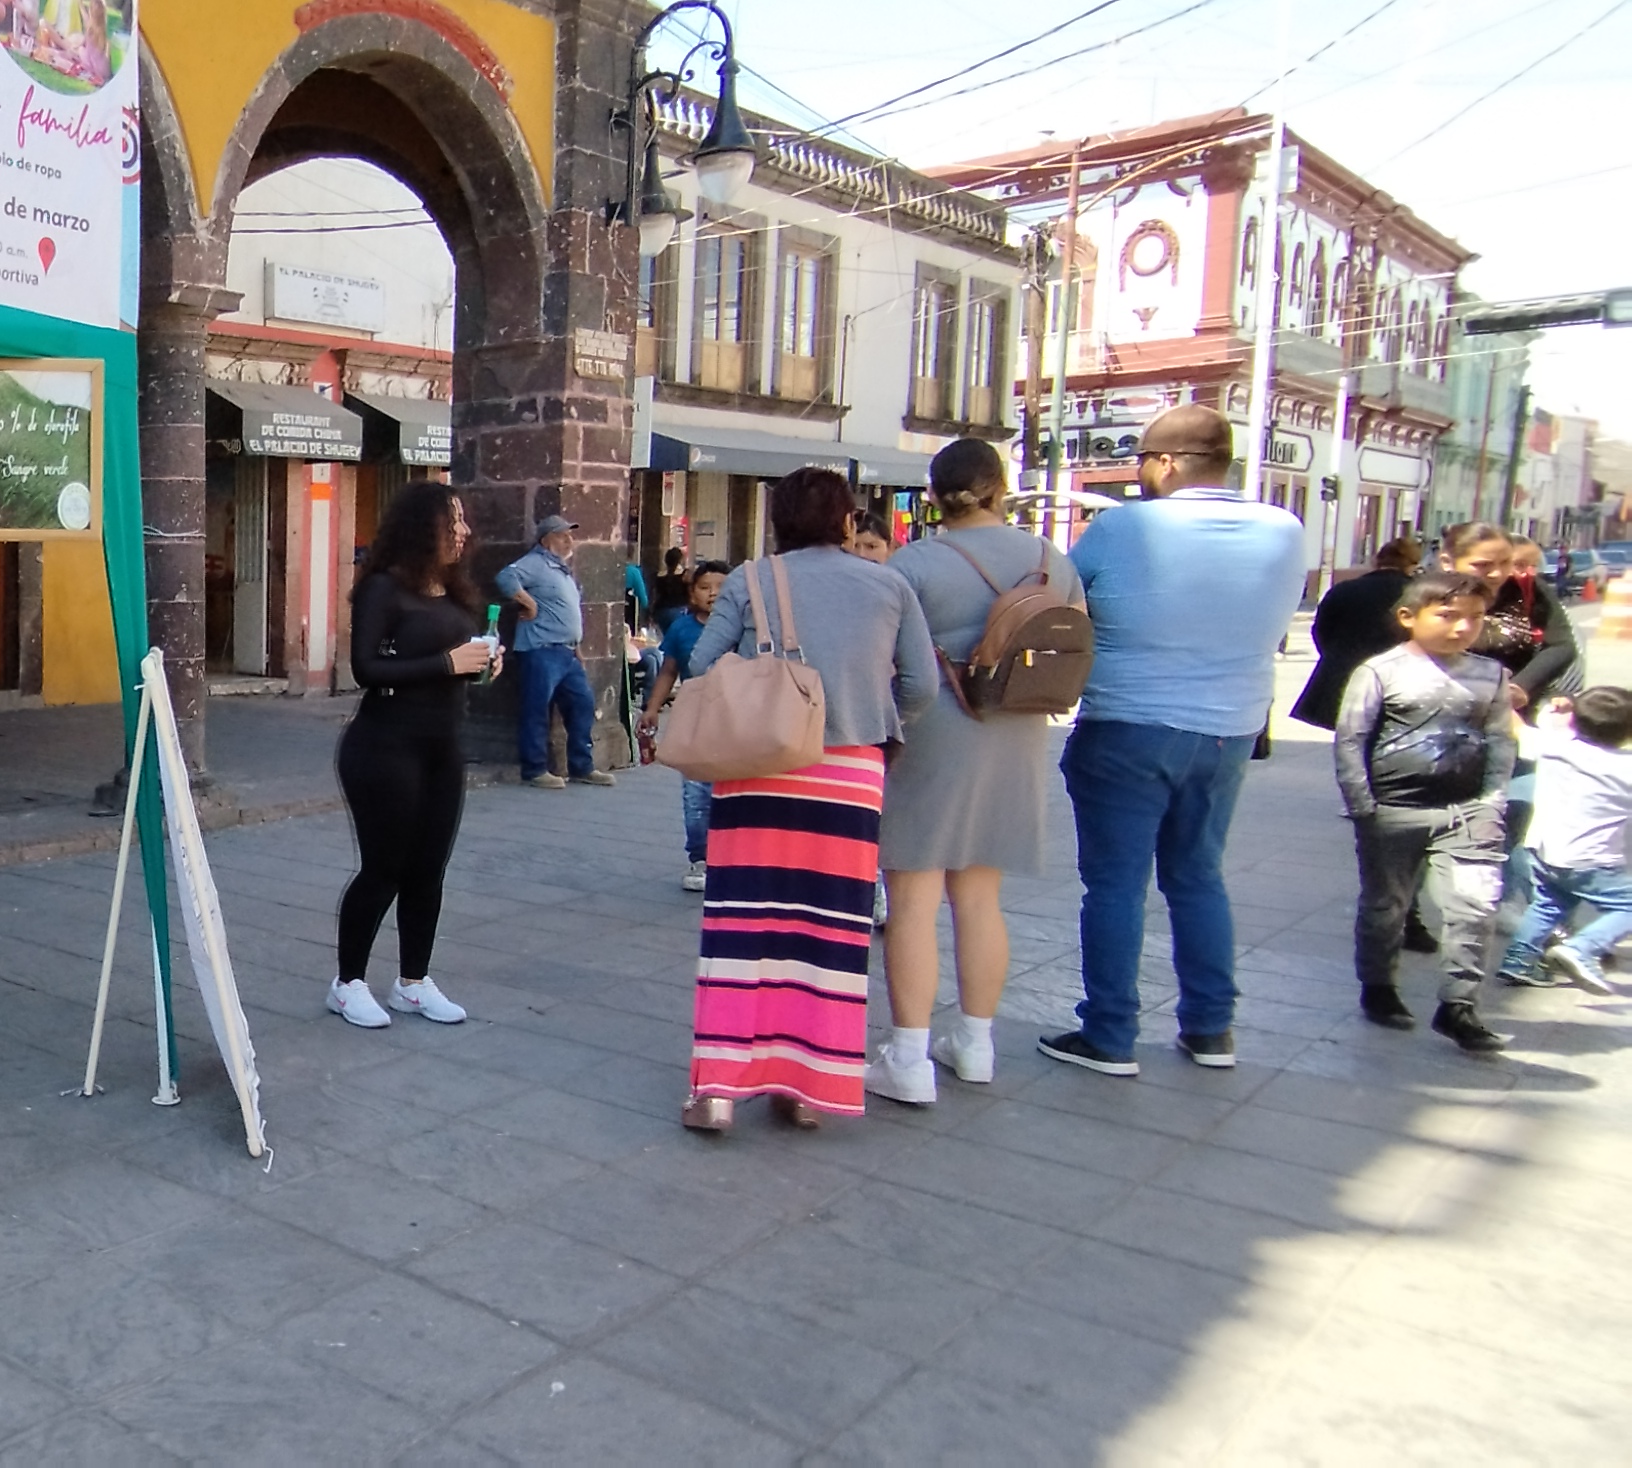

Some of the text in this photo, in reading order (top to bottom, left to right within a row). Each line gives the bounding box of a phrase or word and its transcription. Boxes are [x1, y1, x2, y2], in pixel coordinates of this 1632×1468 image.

[18, 84, 112, 148] familia
[16, 157, 32, 171] de
[35, 164, 62, 180] ropa
[4, 197, 27, 219] de
[33, 206, 90, 232] marzo
[292, 269, 331, 283] PALACIO
[28, 407, 37, 431] de
[261, 425, 274, 436] DE
[276, 426, 312, 438] COMIDA
[249, 440, 263, 452] EL
[264, 440, 308, 454] PALACIO
[309, 442, 322, 454] DE
[402, 448, 413, 460] EL
[44, 455, 68, 475] verde
